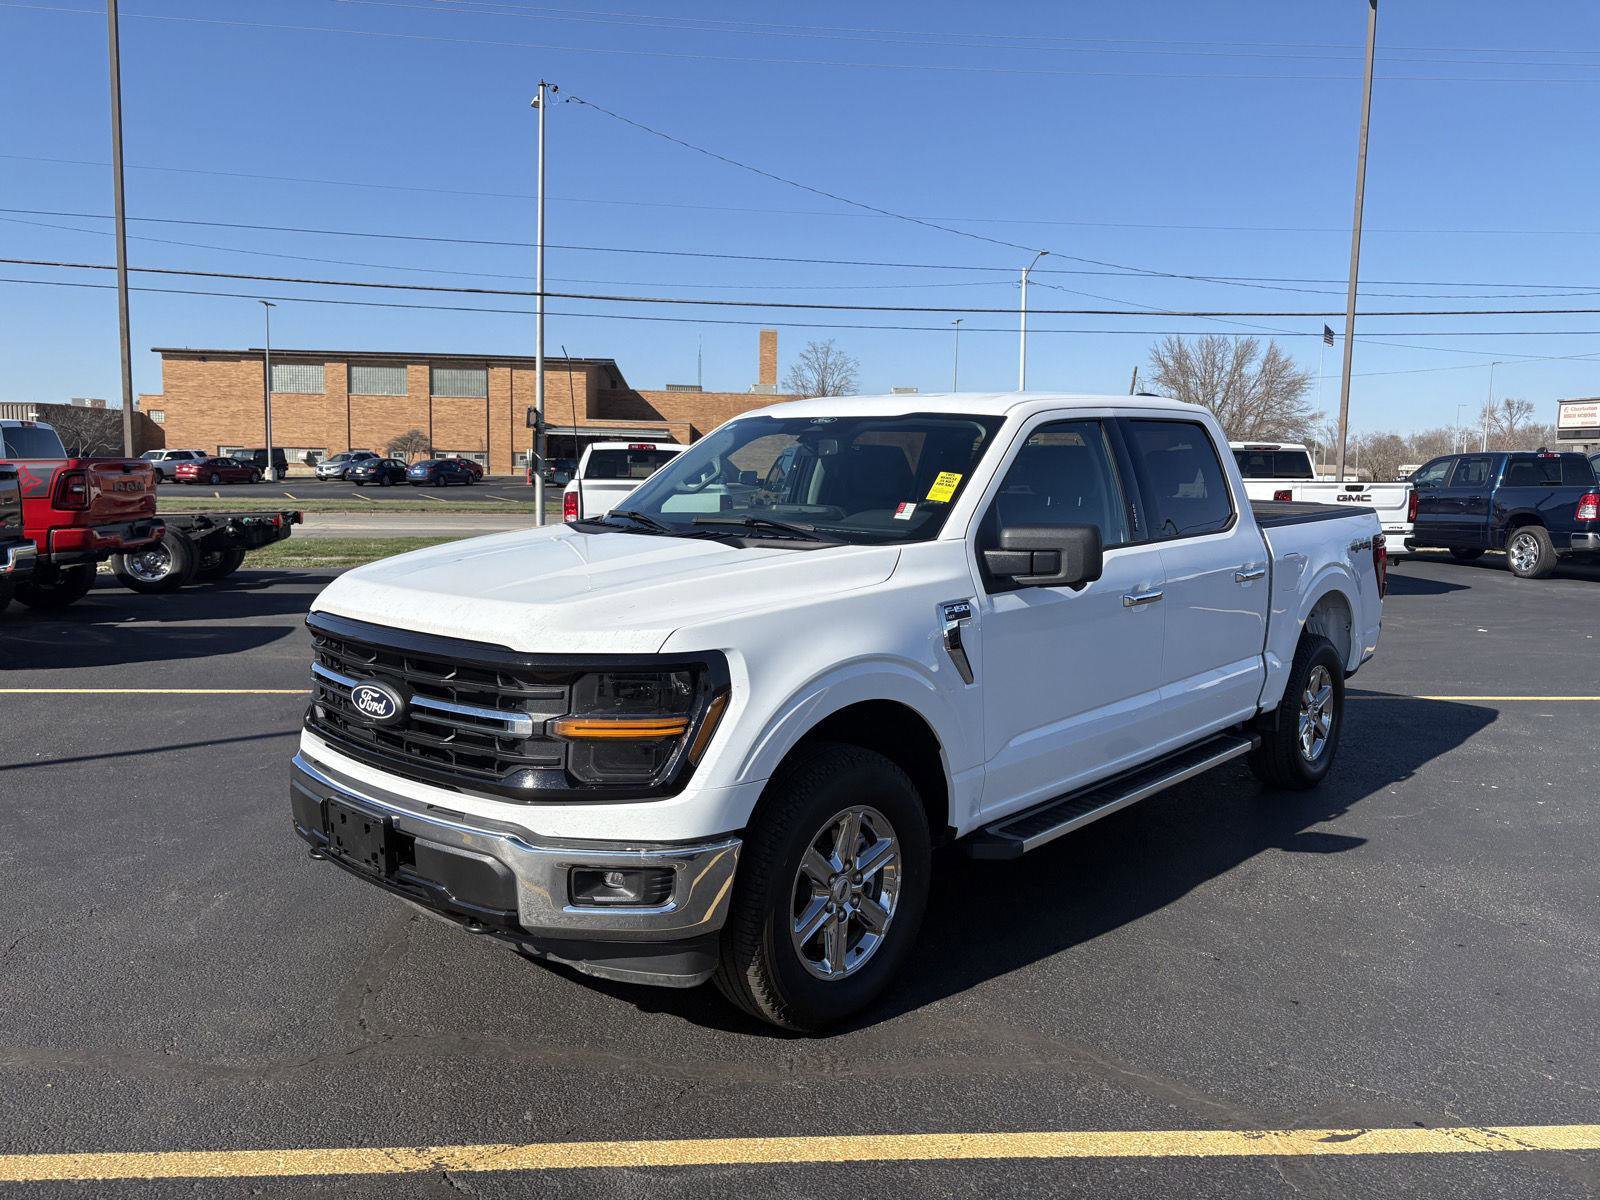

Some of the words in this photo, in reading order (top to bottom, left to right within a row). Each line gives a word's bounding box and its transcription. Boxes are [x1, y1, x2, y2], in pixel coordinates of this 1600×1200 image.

[112, 481, 146, 492] RAM
[1336, 494, 1372, 502] GMC
[944, 603, 970, 614] F-150
[358, 688, 387, 715] Ford
